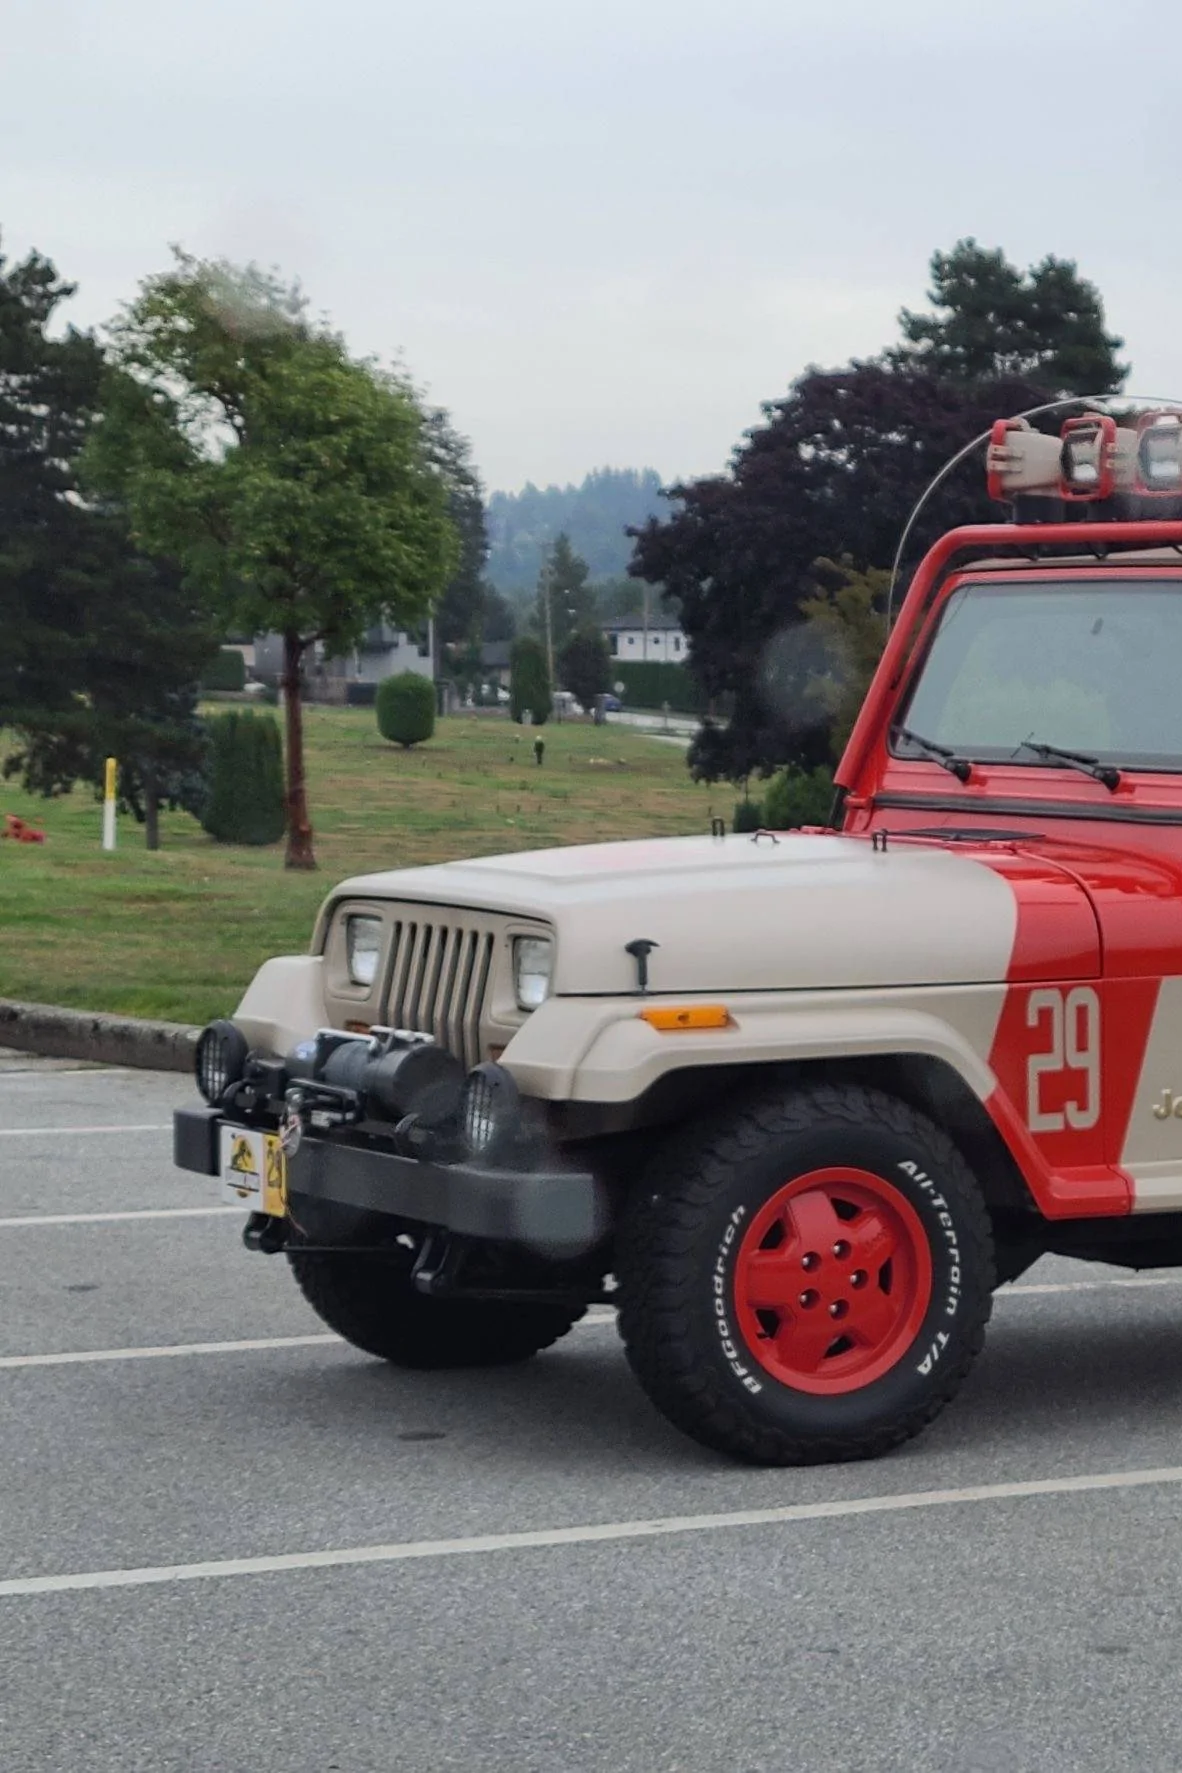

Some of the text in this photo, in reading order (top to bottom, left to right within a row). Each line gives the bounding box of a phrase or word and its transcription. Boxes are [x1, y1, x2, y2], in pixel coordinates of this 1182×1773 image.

[1027, 986, 1100, 1131] 29
[713, 1205, 763, 1394] BFGoodrich
[897, 1160, 961, 1375] All-Terrain T/A
